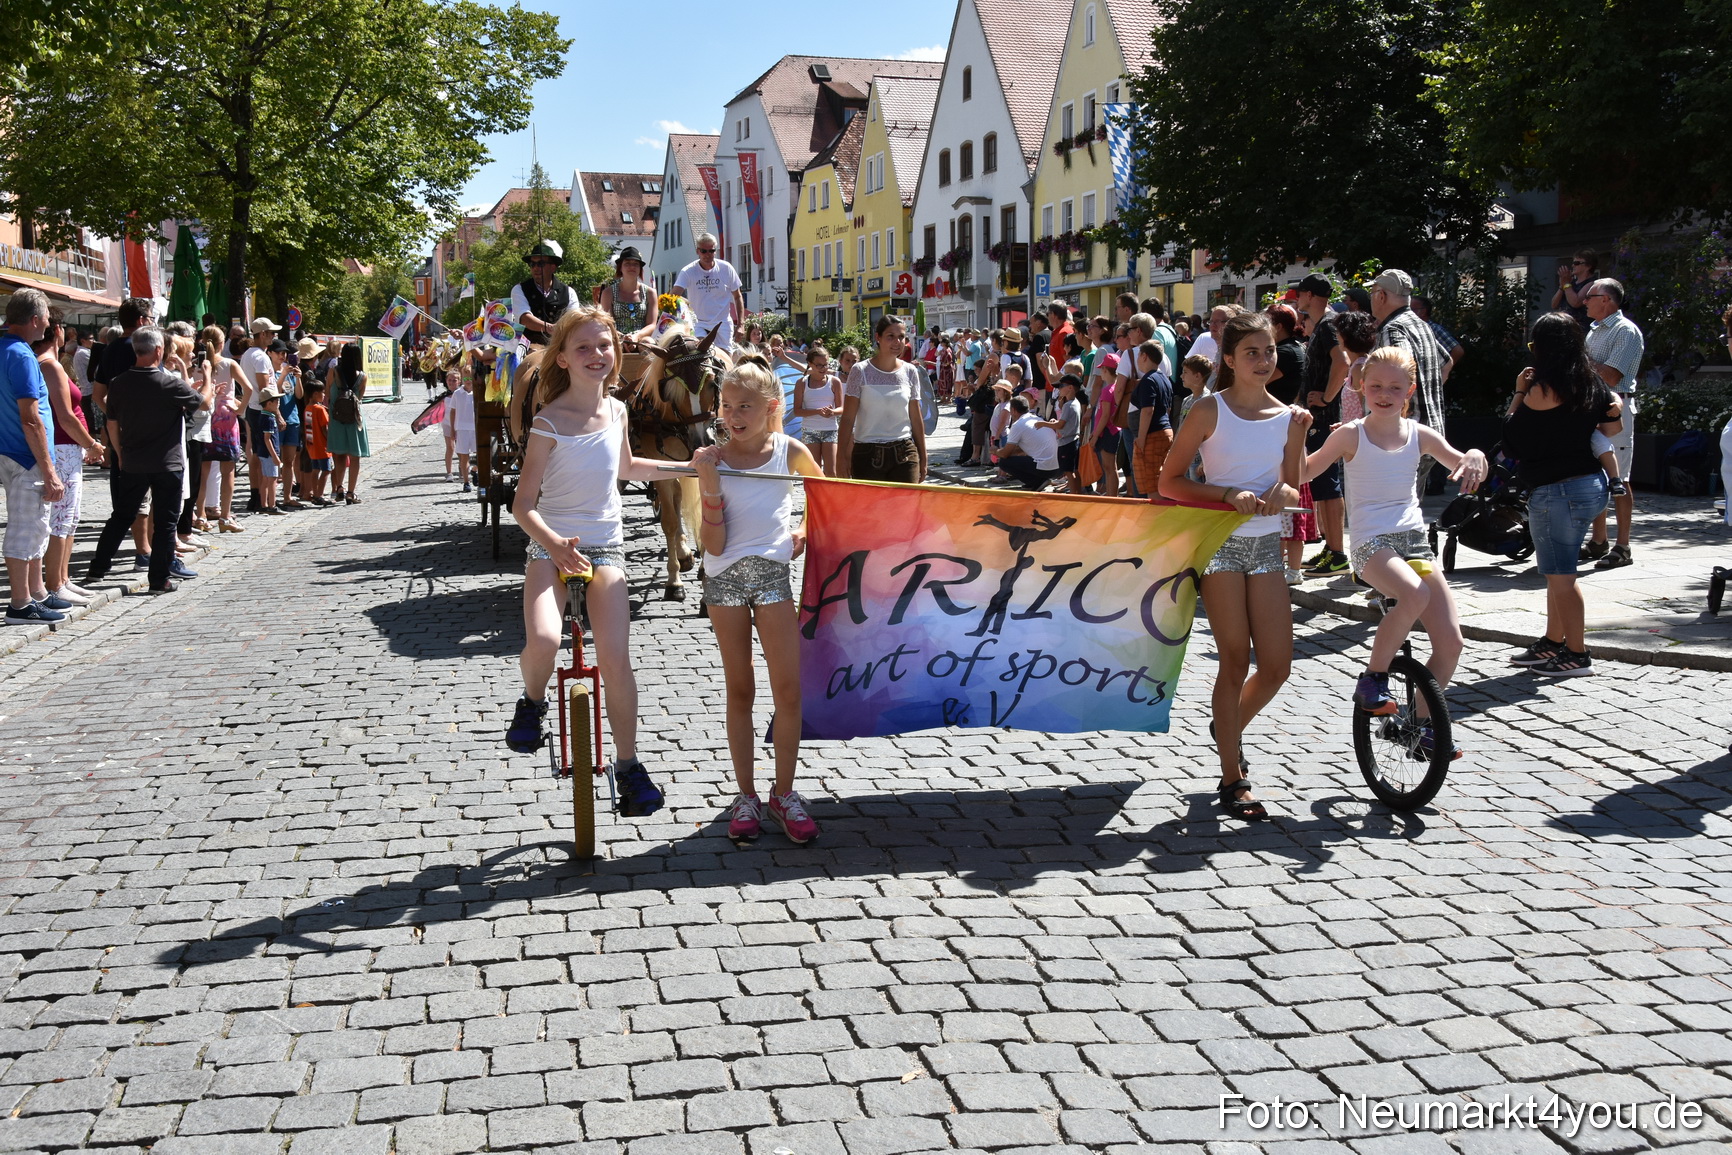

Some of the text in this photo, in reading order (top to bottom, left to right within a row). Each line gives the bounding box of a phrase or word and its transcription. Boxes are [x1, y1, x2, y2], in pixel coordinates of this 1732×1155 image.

[741, 156, 752, 183] K&L
[816, 225, 830, 240] HOTEL
[1038, 277, 1047, 294] P
[368, 344, 389, 363] BOGNER
[826, 638, 1168, 706] art of sports
